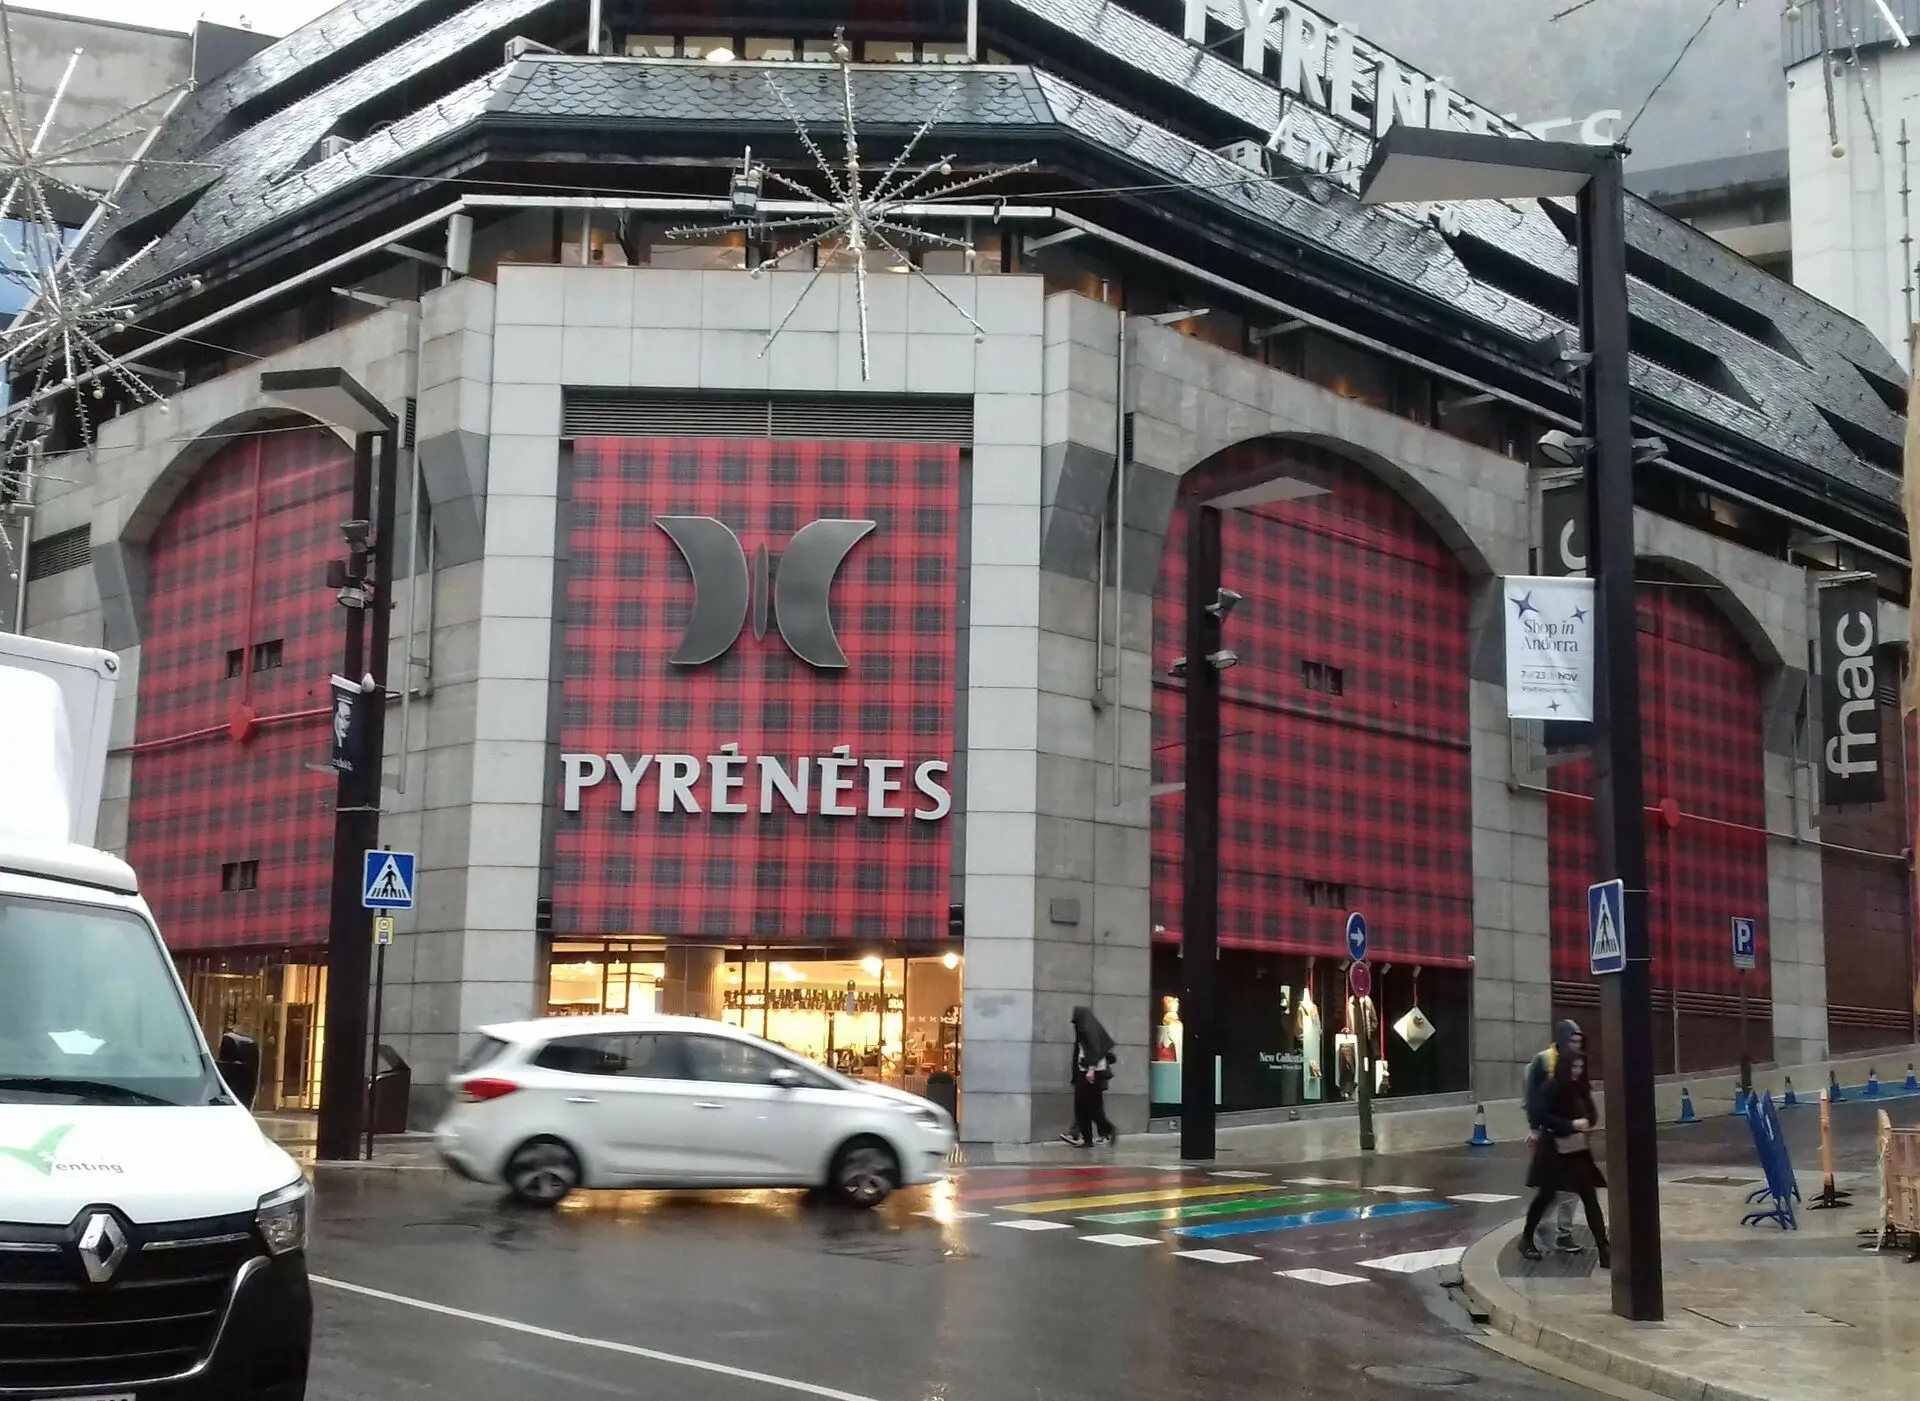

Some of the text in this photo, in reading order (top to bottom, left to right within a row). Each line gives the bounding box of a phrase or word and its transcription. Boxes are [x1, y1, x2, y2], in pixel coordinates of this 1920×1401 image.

[1524, 619, 1575, 638] Shop in
[1520, 636, 1579, 652] Andorra
[1536, 671, 1546, 680] 23
[1826, 611, 1878, 778] fnac
[561, 743, 952, 820] PYRÉNÉES
[1735, 920, 1751, 951] P
[1259, 1051, 1275, 1063] New
